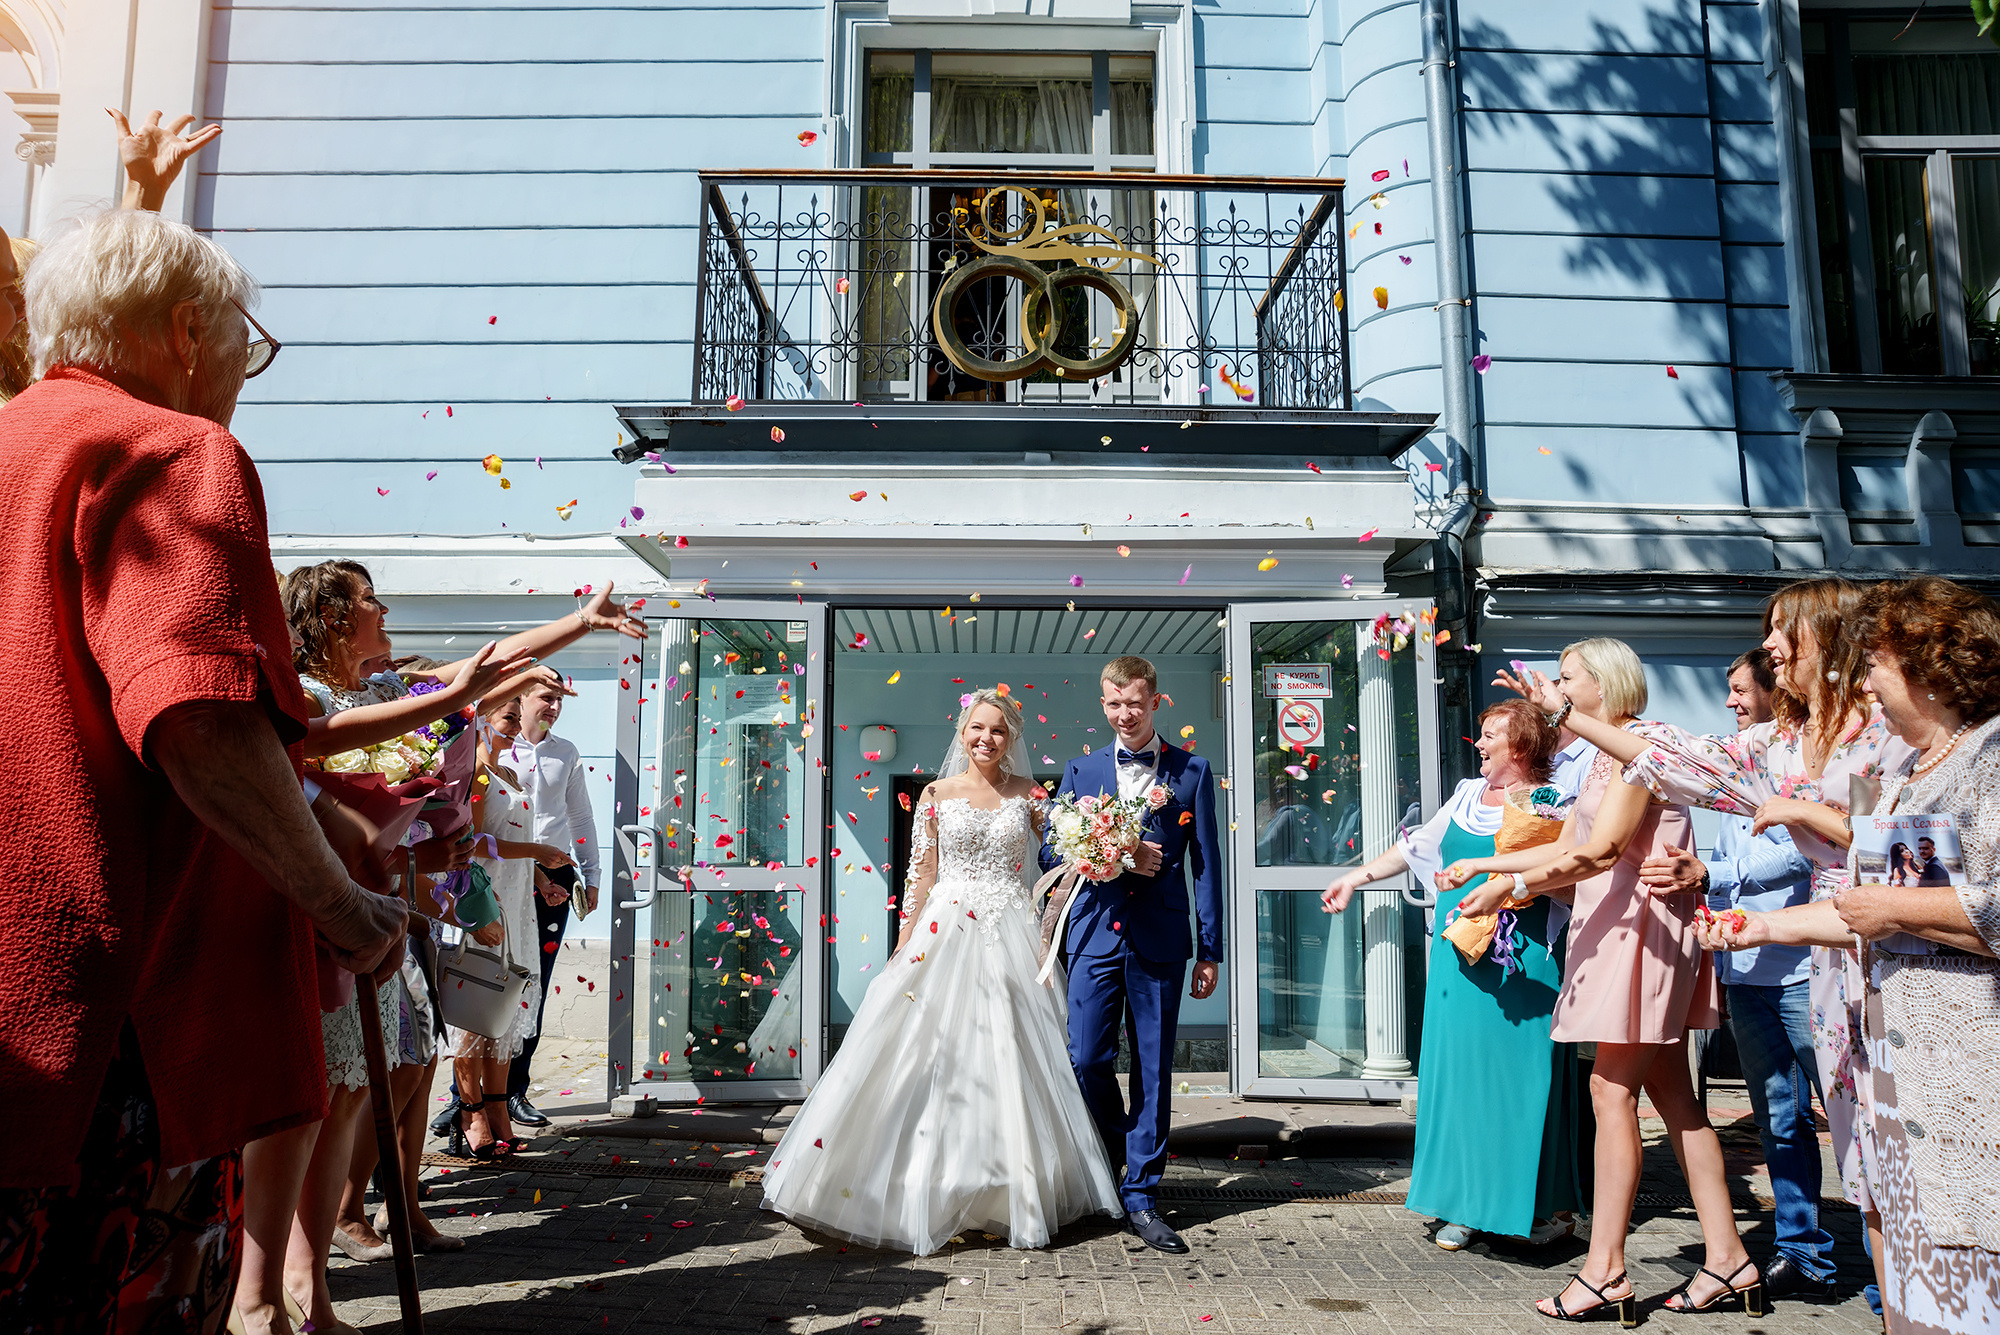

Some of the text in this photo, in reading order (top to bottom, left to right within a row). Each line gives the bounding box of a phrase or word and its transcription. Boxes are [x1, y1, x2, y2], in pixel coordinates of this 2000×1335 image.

[1873, 817, 1950, 834] Брак и Семья
